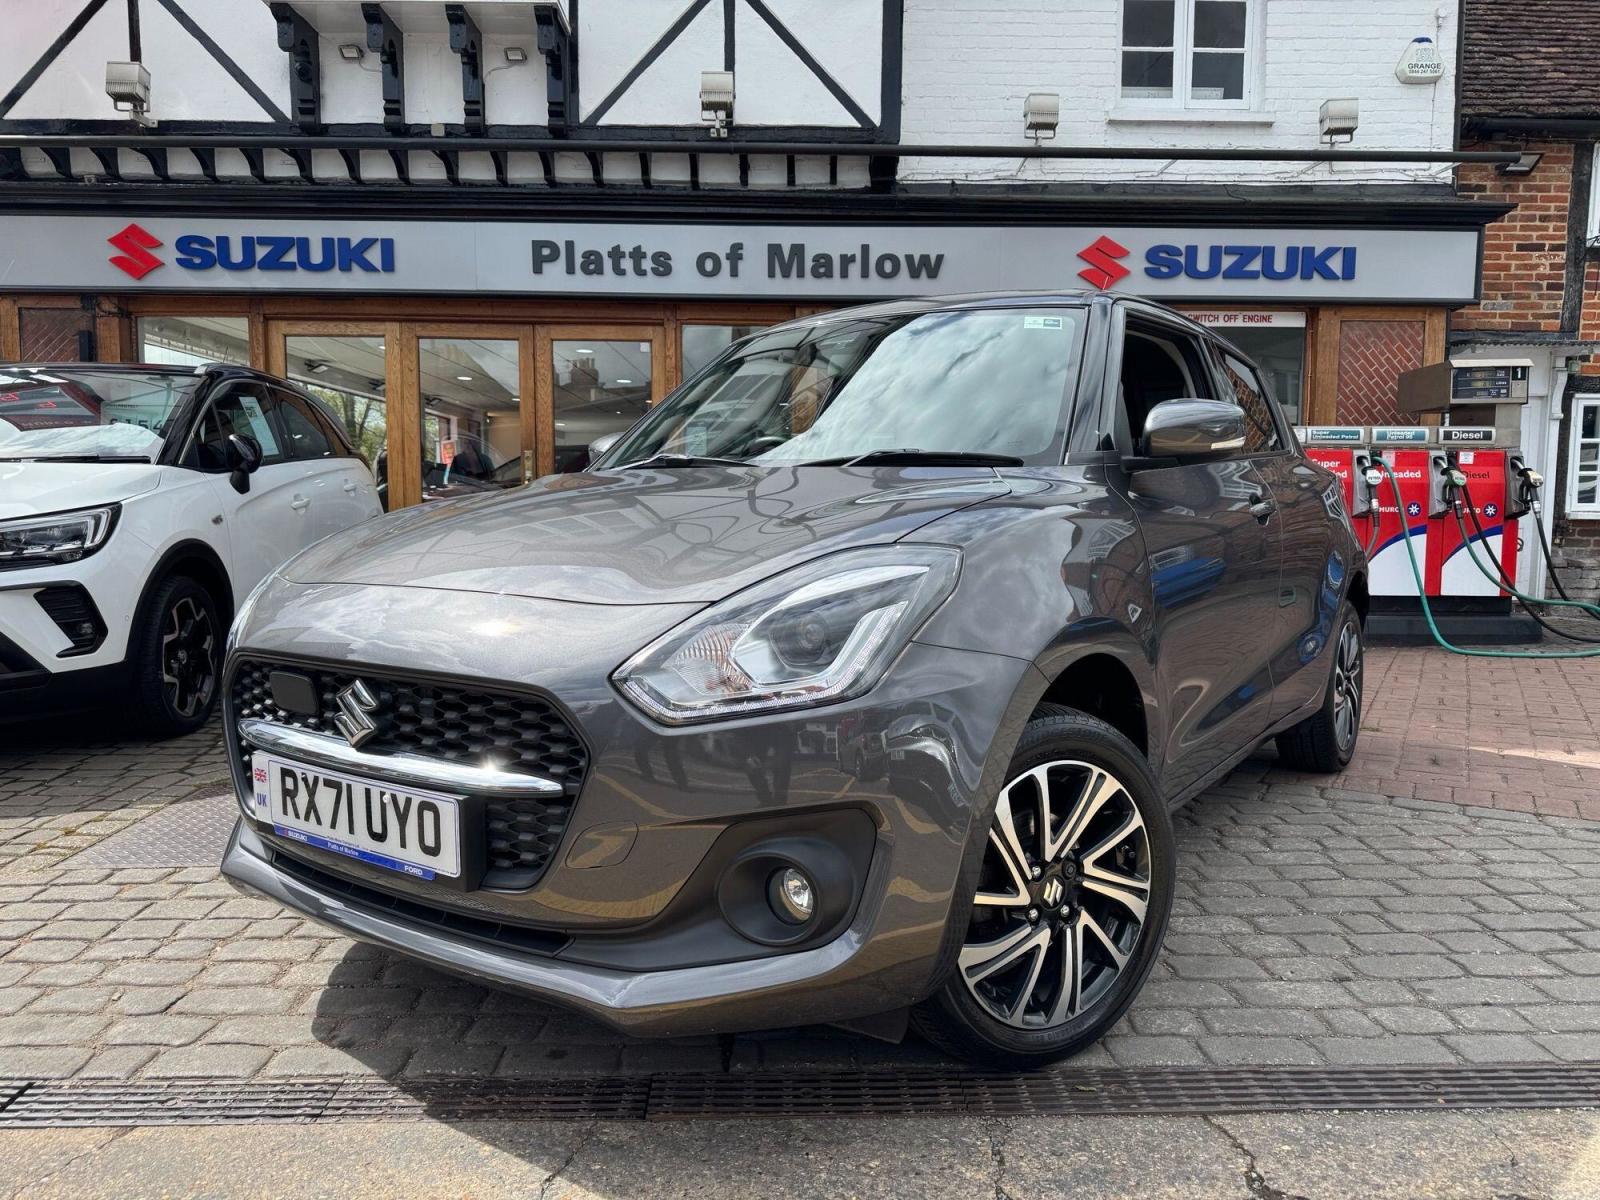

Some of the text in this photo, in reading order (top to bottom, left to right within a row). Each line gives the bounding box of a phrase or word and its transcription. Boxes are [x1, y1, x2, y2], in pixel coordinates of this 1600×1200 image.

[175, 234, 396, 273] SUZUKI
[531, 239, 945, 279] Platts of Marlow
[1144, 244, 1357, 280] SUZUKI
[1223, 314, 1239, 323] OFF
[1242, 314, 1273, 323] ENGINE
[1516, 367, 1522, 379] 1
[1452, 431, 1483, 440] Diesel
[257, 792, 268, 808] UK
[287, 830, 308, 842] SUZUKI
[404, 865, 423, 876] FORD
